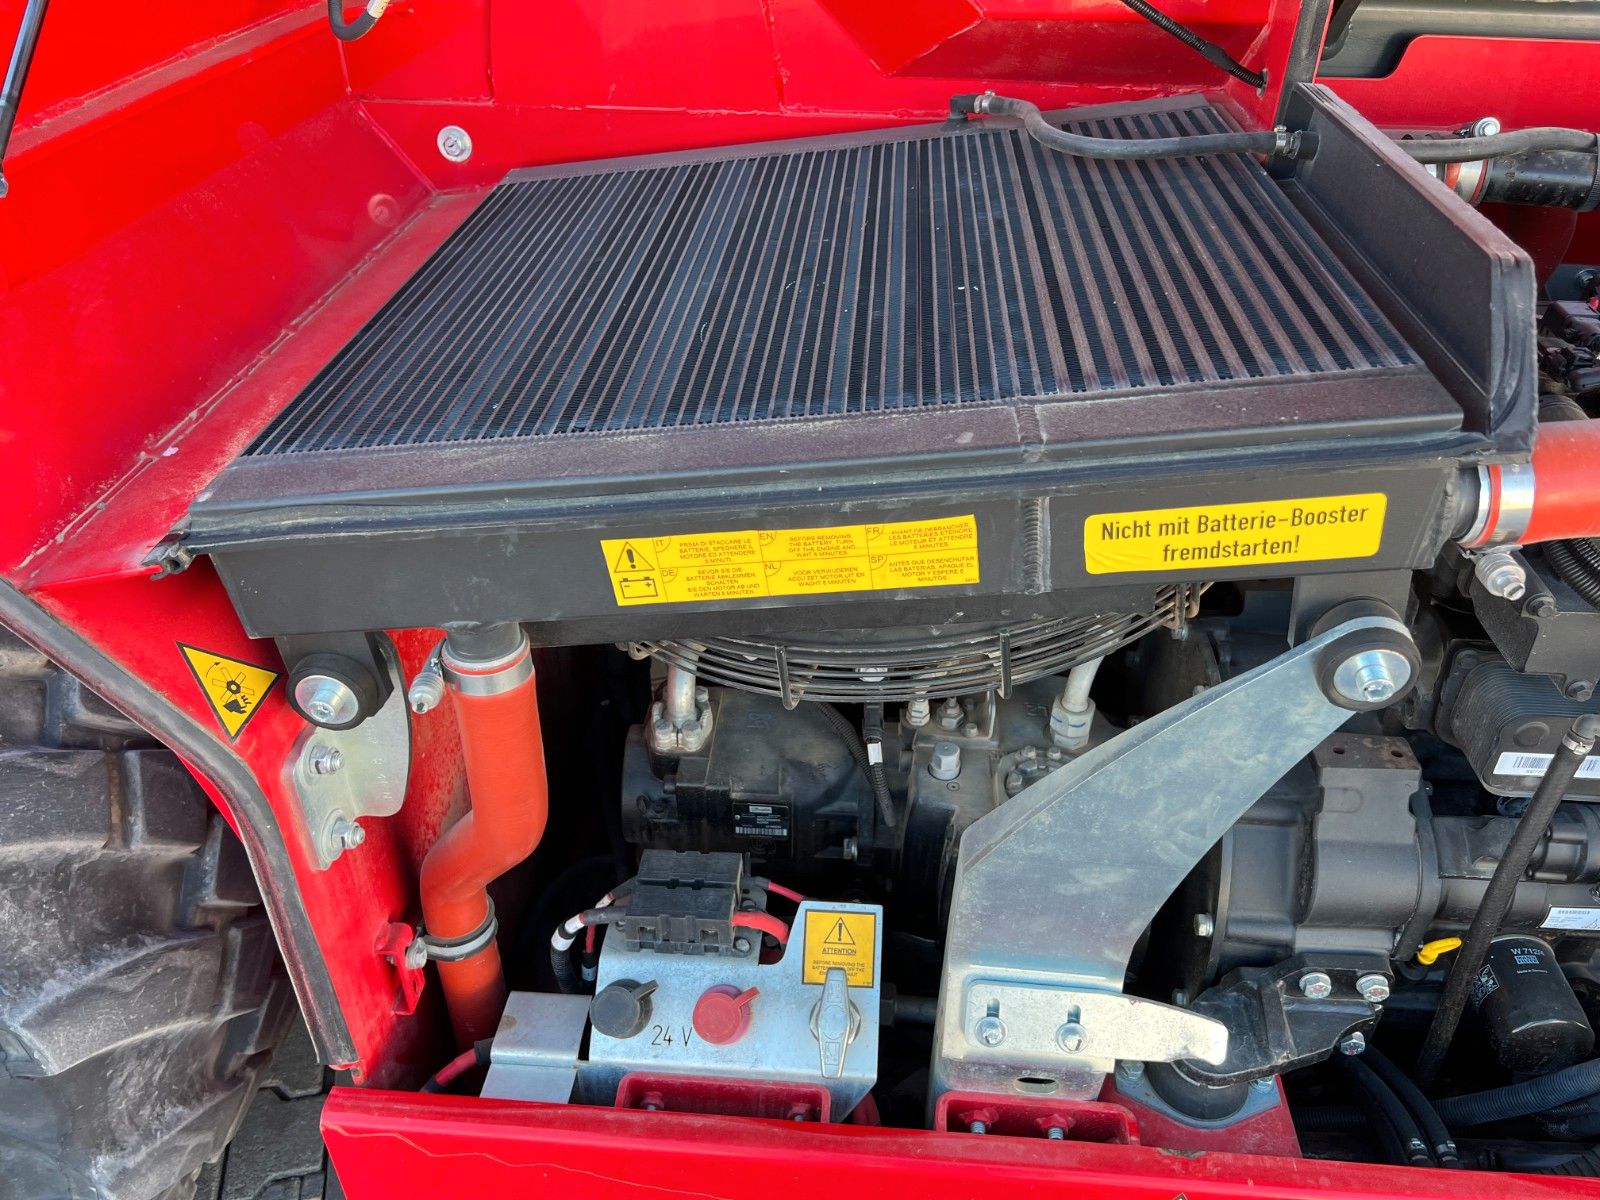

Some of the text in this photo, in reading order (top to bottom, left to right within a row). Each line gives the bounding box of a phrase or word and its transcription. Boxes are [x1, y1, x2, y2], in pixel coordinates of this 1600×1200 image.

[1102, 505, 1368, 541] Nicht mit Batterie-Booster
[1162, 535, 1300, 562] fremdstarten!
[651, 1025, 693, 1046] 24 V
